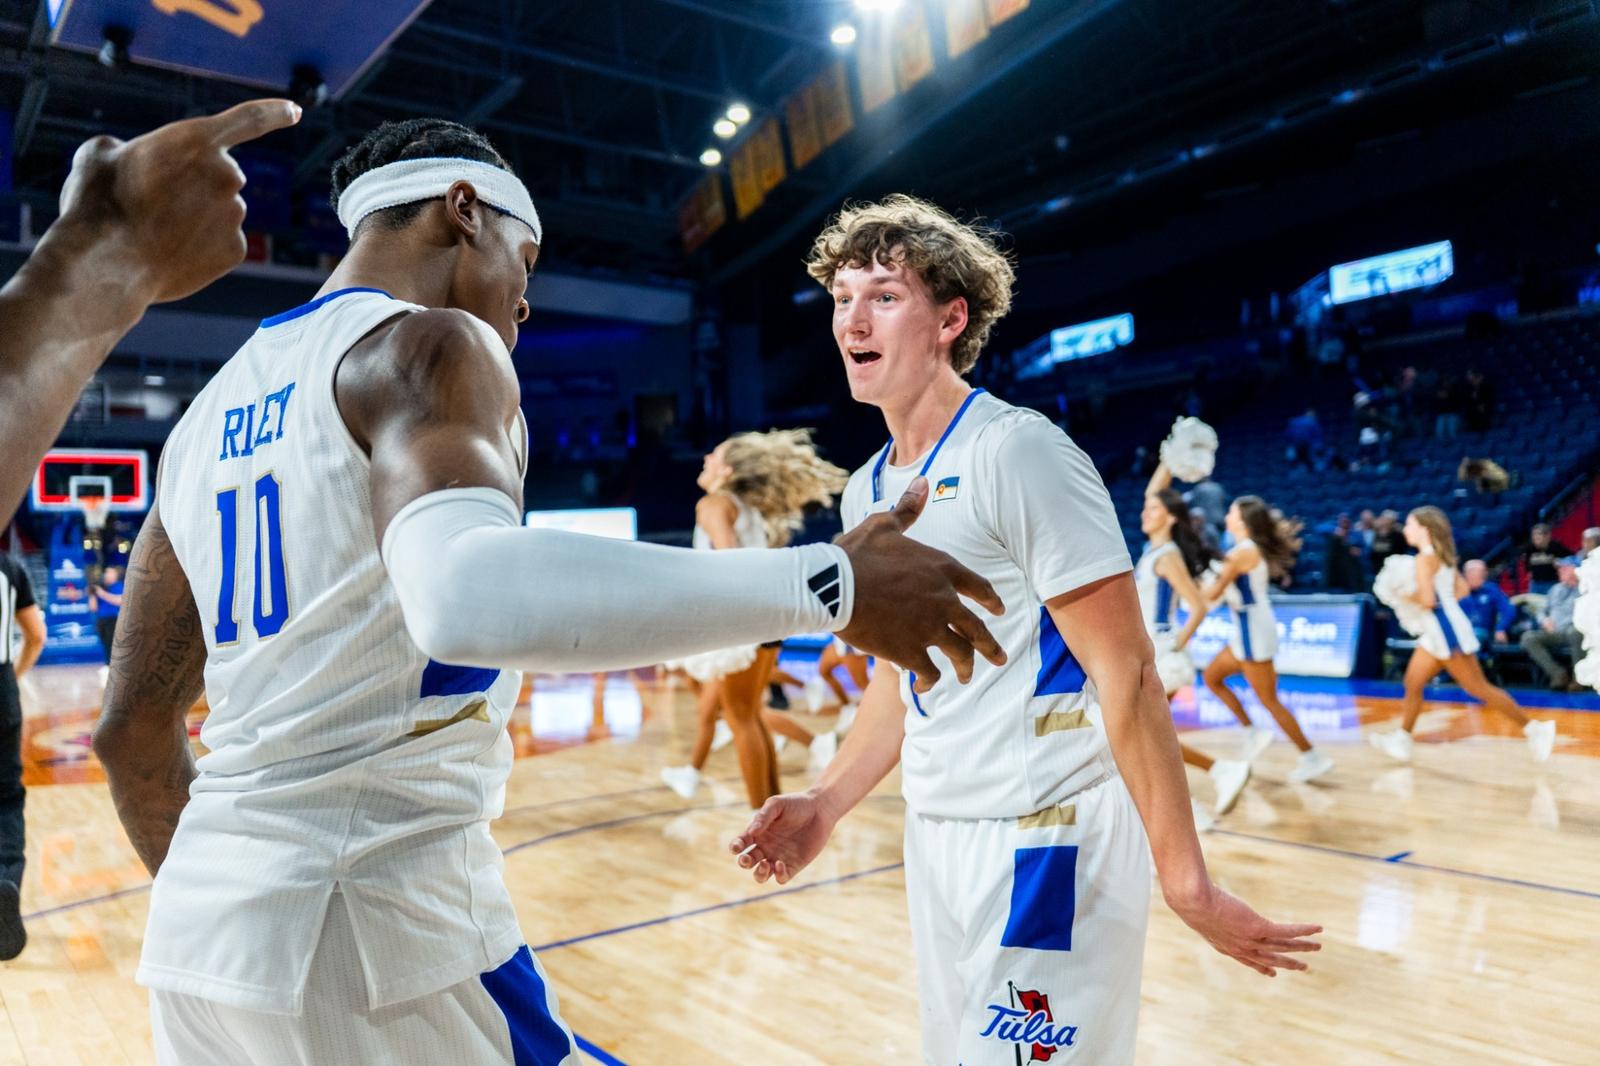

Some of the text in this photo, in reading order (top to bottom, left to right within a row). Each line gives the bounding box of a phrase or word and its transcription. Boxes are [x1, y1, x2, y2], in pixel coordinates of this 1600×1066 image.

[219, 382, 296, 461] RIEY
[214, 470, 294, 646] 10
[979, 1004, 1078, 1046] Tulsa
